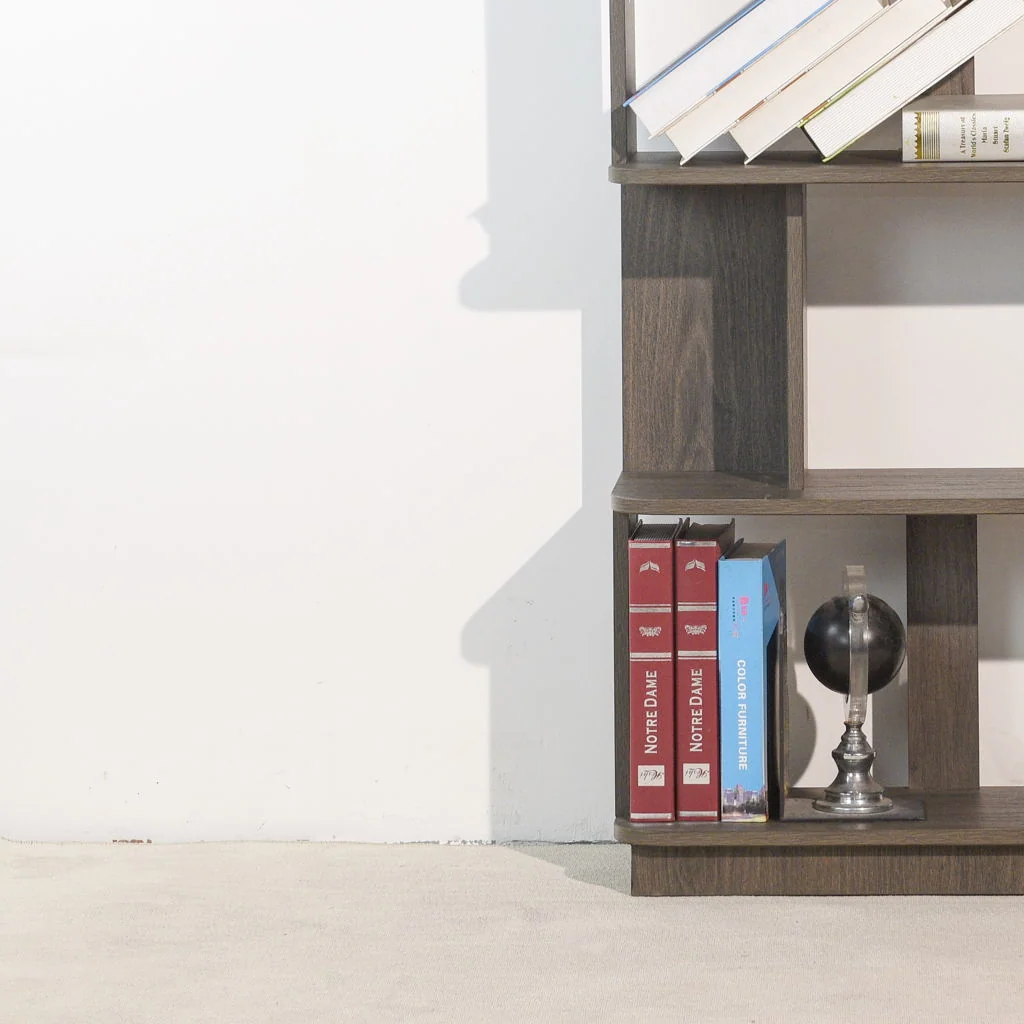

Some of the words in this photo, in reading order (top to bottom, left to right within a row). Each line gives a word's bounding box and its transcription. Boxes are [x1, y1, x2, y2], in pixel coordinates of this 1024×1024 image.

[644, 670, 657, 707] DAME
[690, 669, 702, 706] DAME
[737, 660, 746, 700] COLOR
[644, 710, 657, 754] NOTRE
[690, 709, 702, 752] NOTRE
[738, 704, 748, 771] FURNITURE
